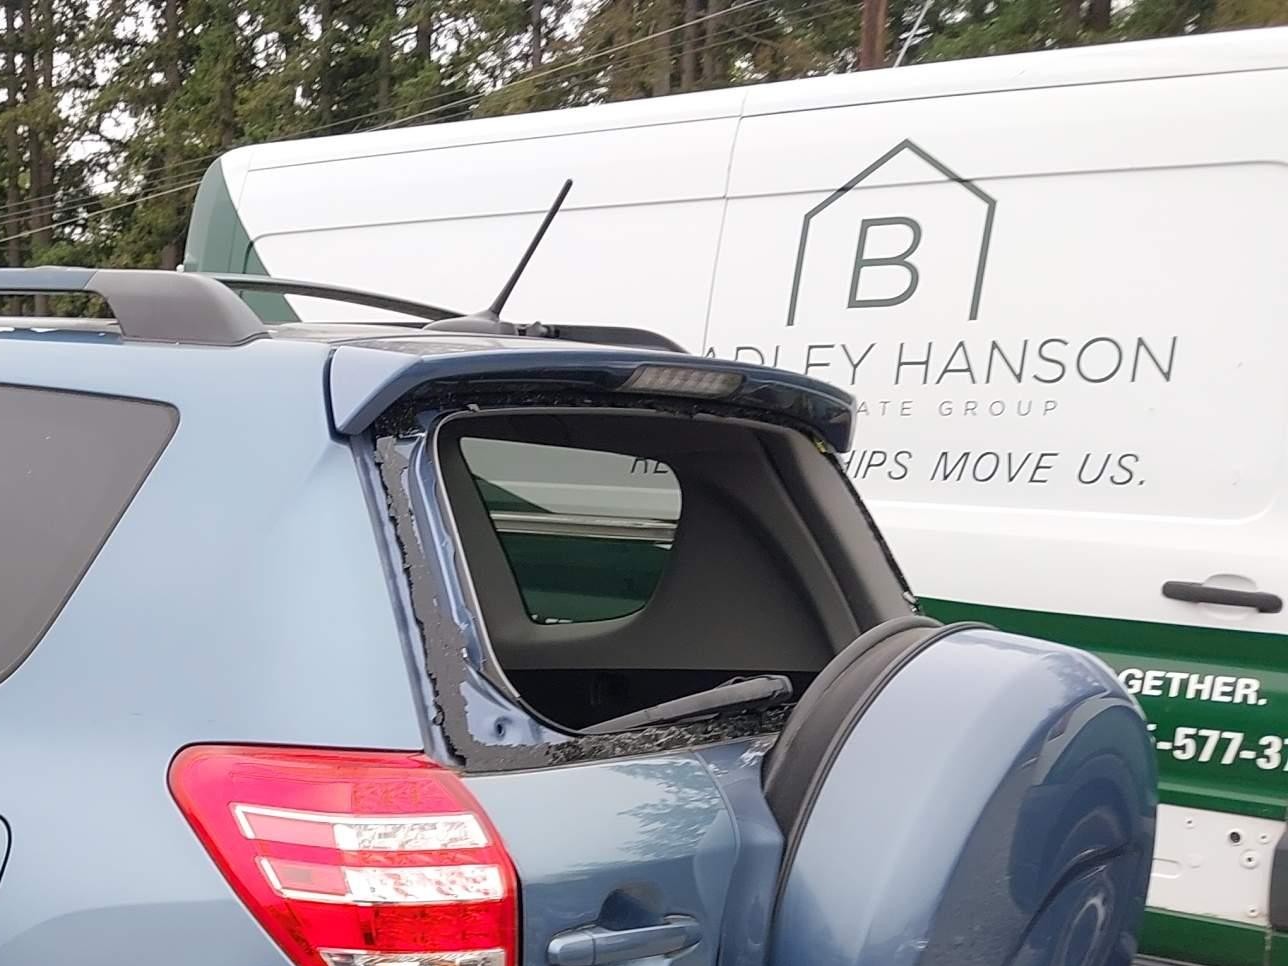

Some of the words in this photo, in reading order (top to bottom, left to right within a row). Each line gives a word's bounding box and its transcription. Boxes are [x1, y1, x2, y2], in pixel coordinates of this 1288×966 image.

[847, 216, 922, 309] B
[894, 335, 1178, 385] HANSON
[938, 400, 1059, 417] GROUP
[930, 451, 1059, 484] MOVE
[1078, 452, 1146, 486] US.
[1117, 668, 1268, 706] GETHER.
[1146, 723, 1288, 772] -577-3
